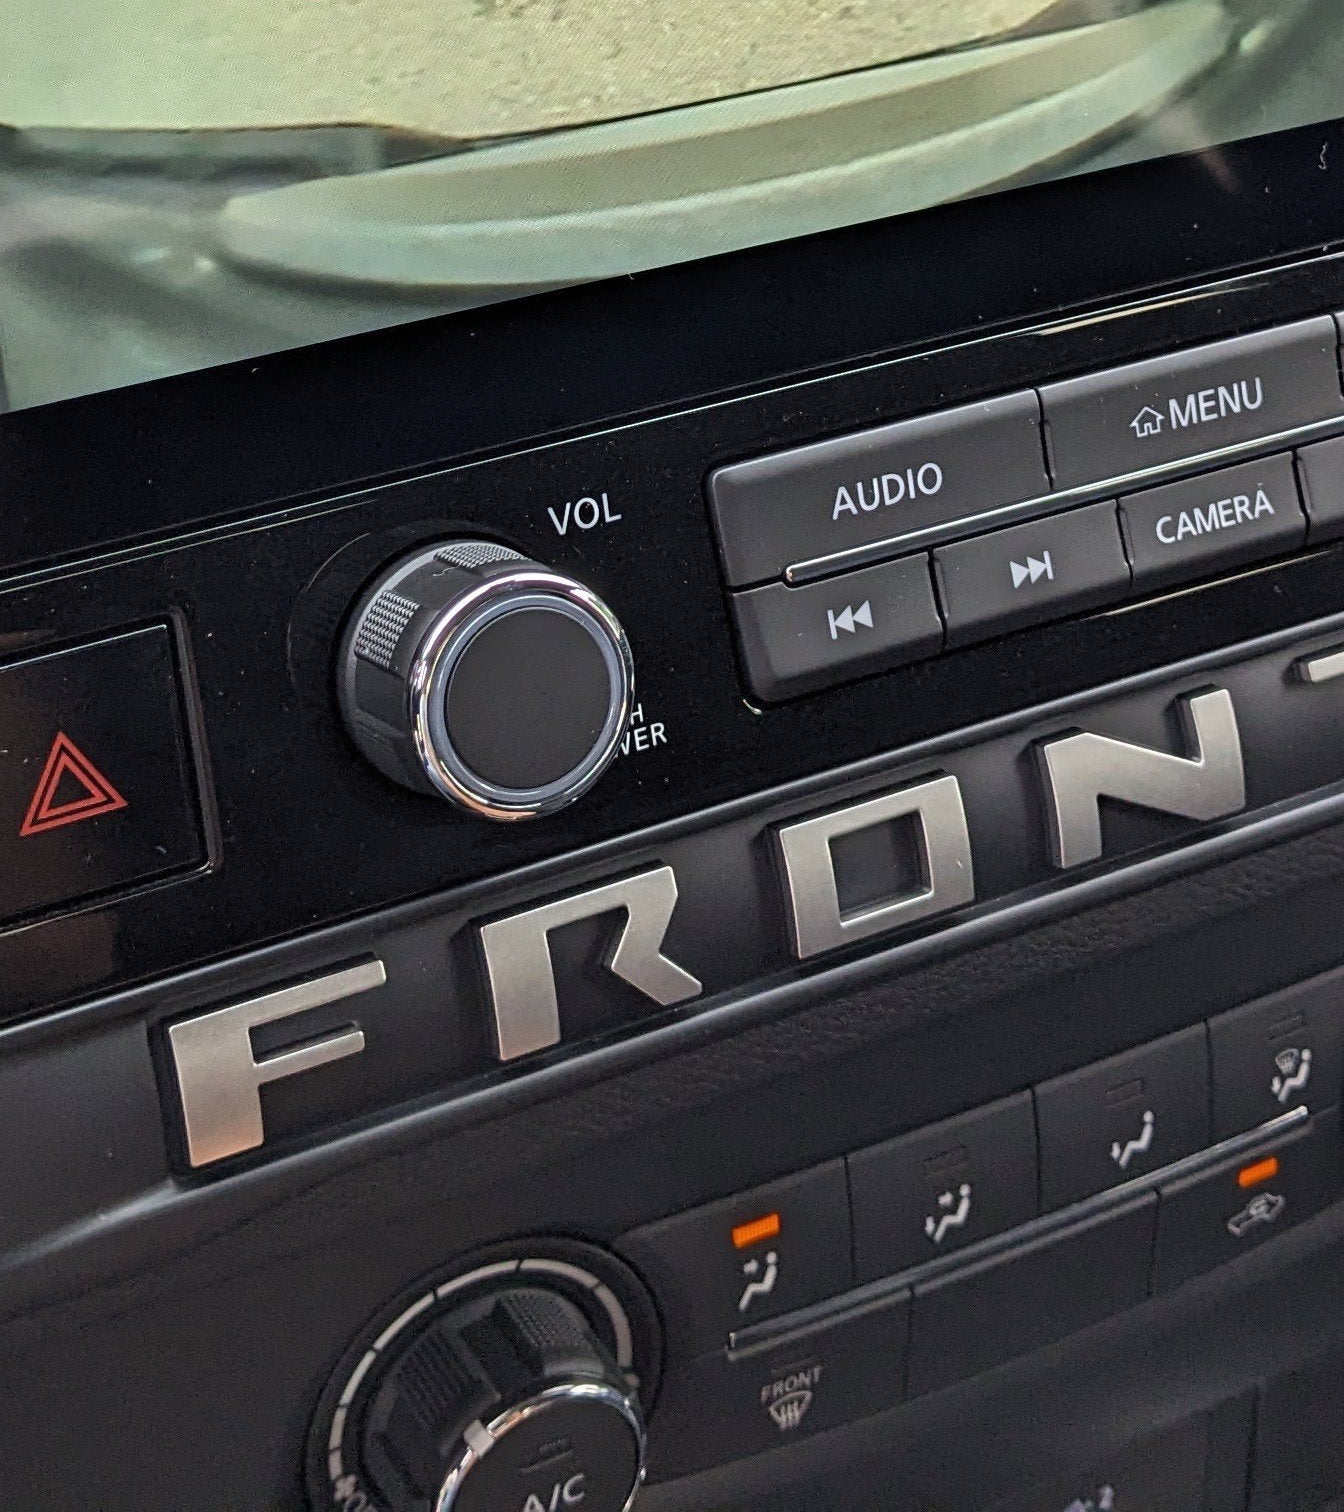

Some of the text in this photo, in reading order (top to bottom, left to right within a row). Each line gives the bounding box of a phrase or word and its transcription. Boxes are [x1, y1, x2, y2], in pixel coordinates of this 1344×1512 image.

[1168, 377, 1264, 430] MENU
[547, 492, 623, 536] VOL
[830, 462, 944, 521] AUDIO
[1155, 491, 1276, 545] CAMERA
[760, 1365, 824, 1405] FRONT
